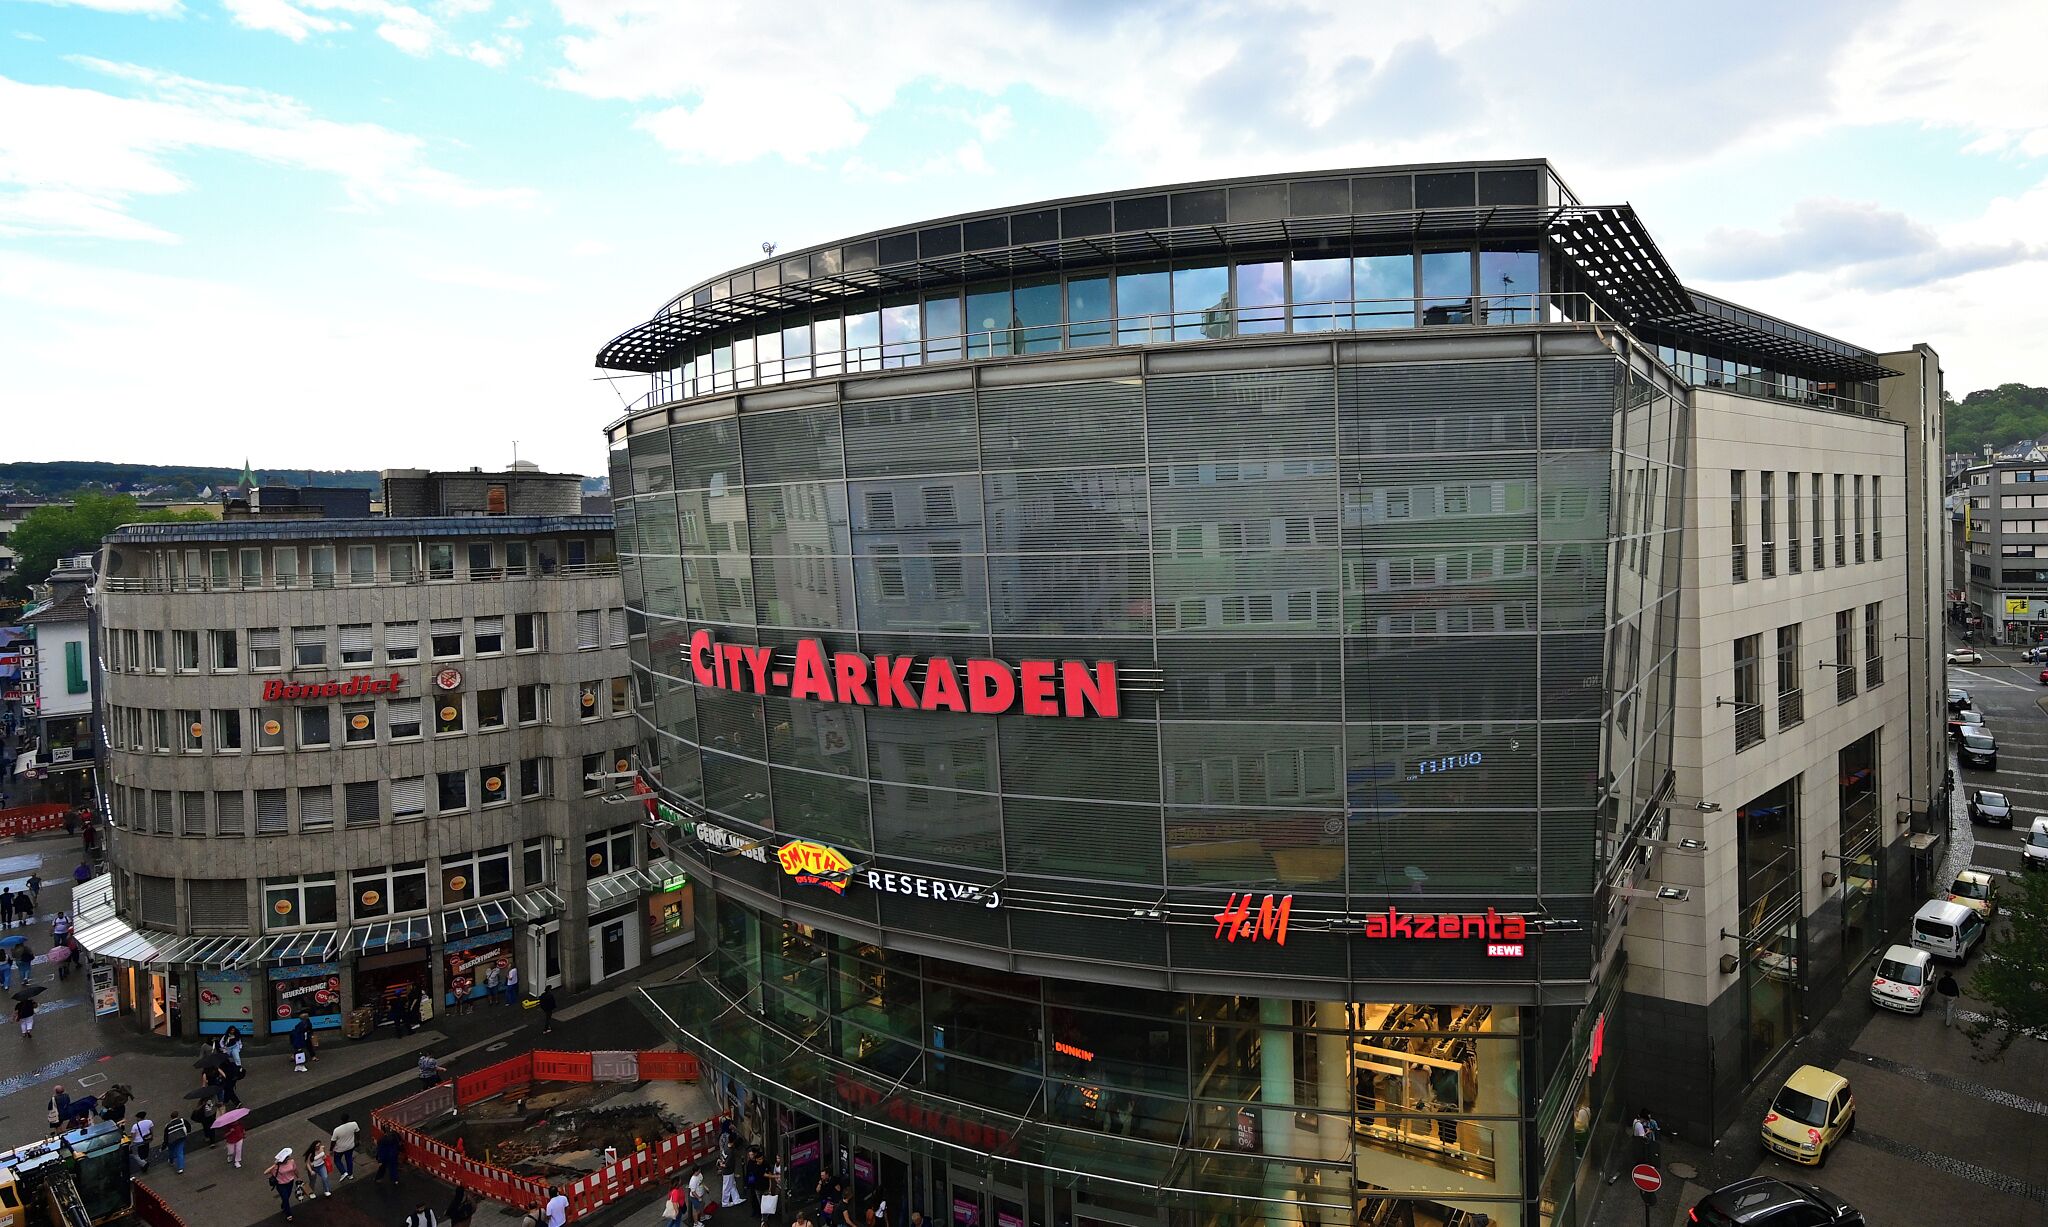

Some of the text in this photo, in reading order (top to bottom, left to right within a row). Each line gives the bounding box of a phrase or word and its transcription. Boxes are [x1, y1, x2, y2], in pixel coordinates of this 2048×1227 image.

[22, 646, 36, 704] OPTIK
[262, 672, 402, 702] Bénédict
[696, 822, 727, 847] GERRY
[1213, 892, 1293, 946] H&M
[1365, 905, 1526, 940] akzenta
[1488, 945, 1522, 956] REWE
[1055, 1041, 1094, 1062] DUNKIN'
